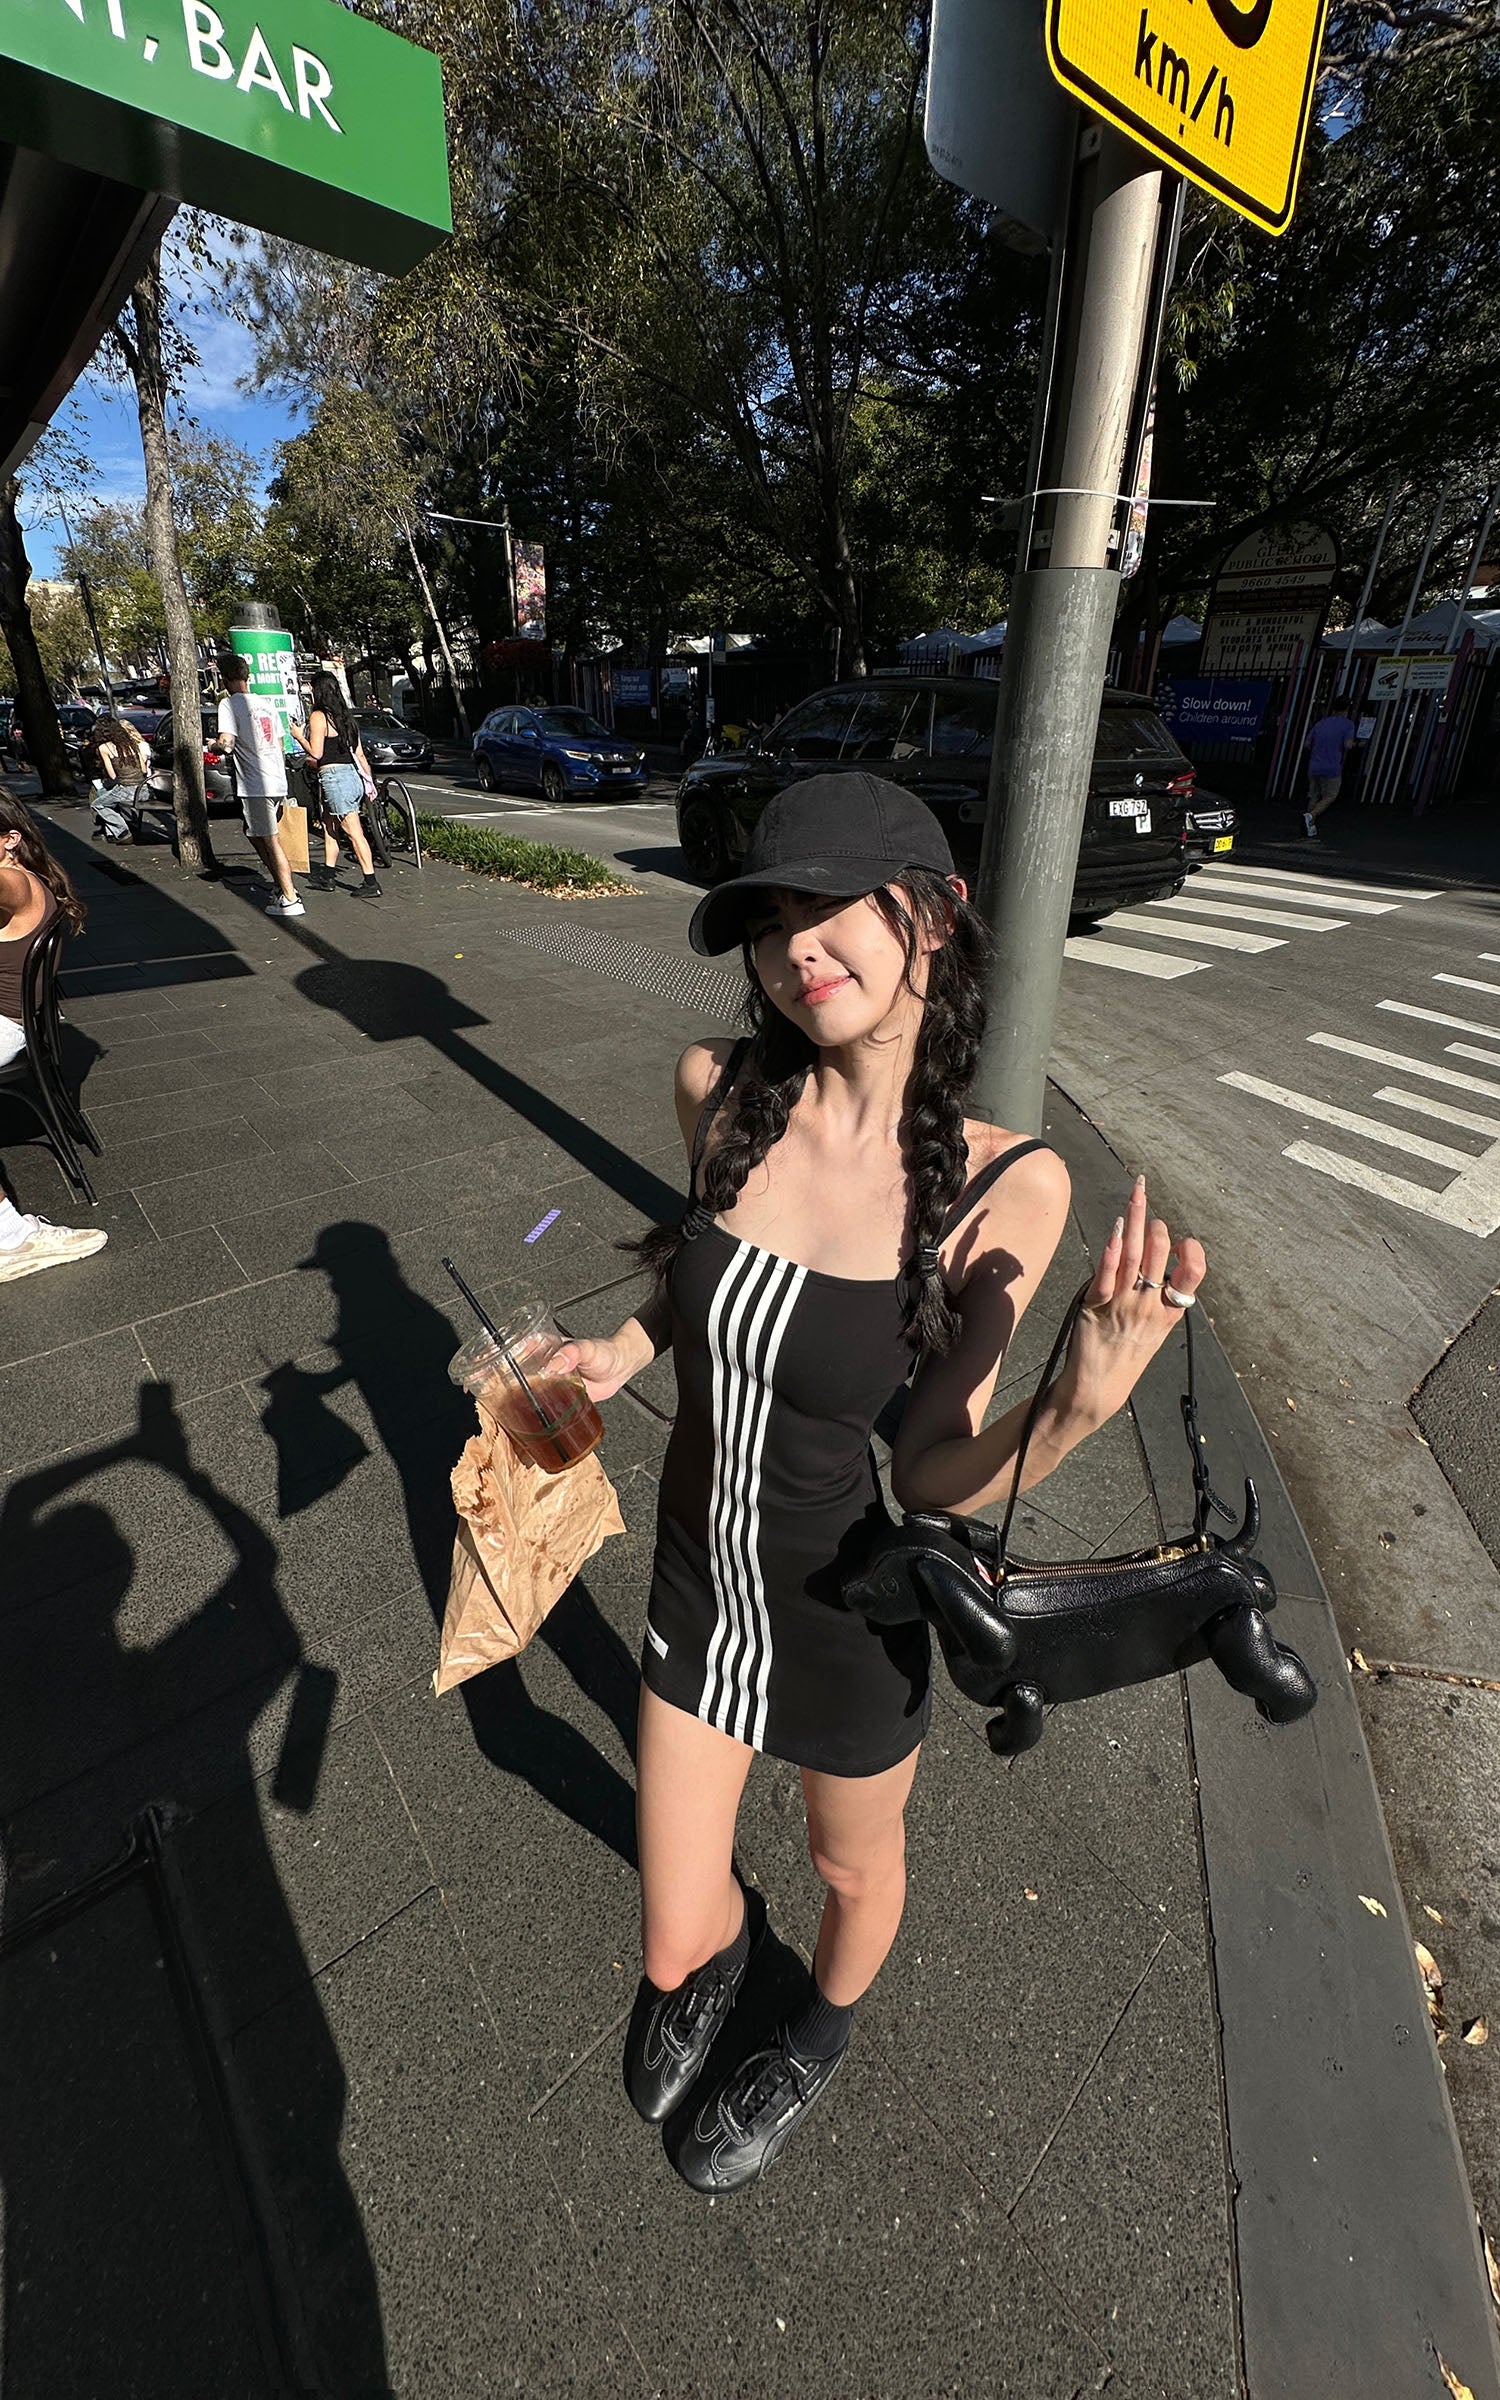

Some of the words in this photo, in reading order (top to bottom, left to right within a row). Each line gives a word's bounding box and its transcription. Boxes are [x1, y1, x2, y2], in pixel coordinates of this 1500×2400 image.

[182, 0, 346, 135] BAR
[1134, 8, 1235, 148] km/h
[1229, 558, 1274, 570] PUBLIC
[1241, 577, 1271, 588] 9660
[1274, 575, 1305, 585] 4549
[1181, 697, 1211, 710] Slow
[1212, 698, 1252, 711] down!
[1178, 711, 1219, 723] Children
[1221, 715, 1258, 726] around
